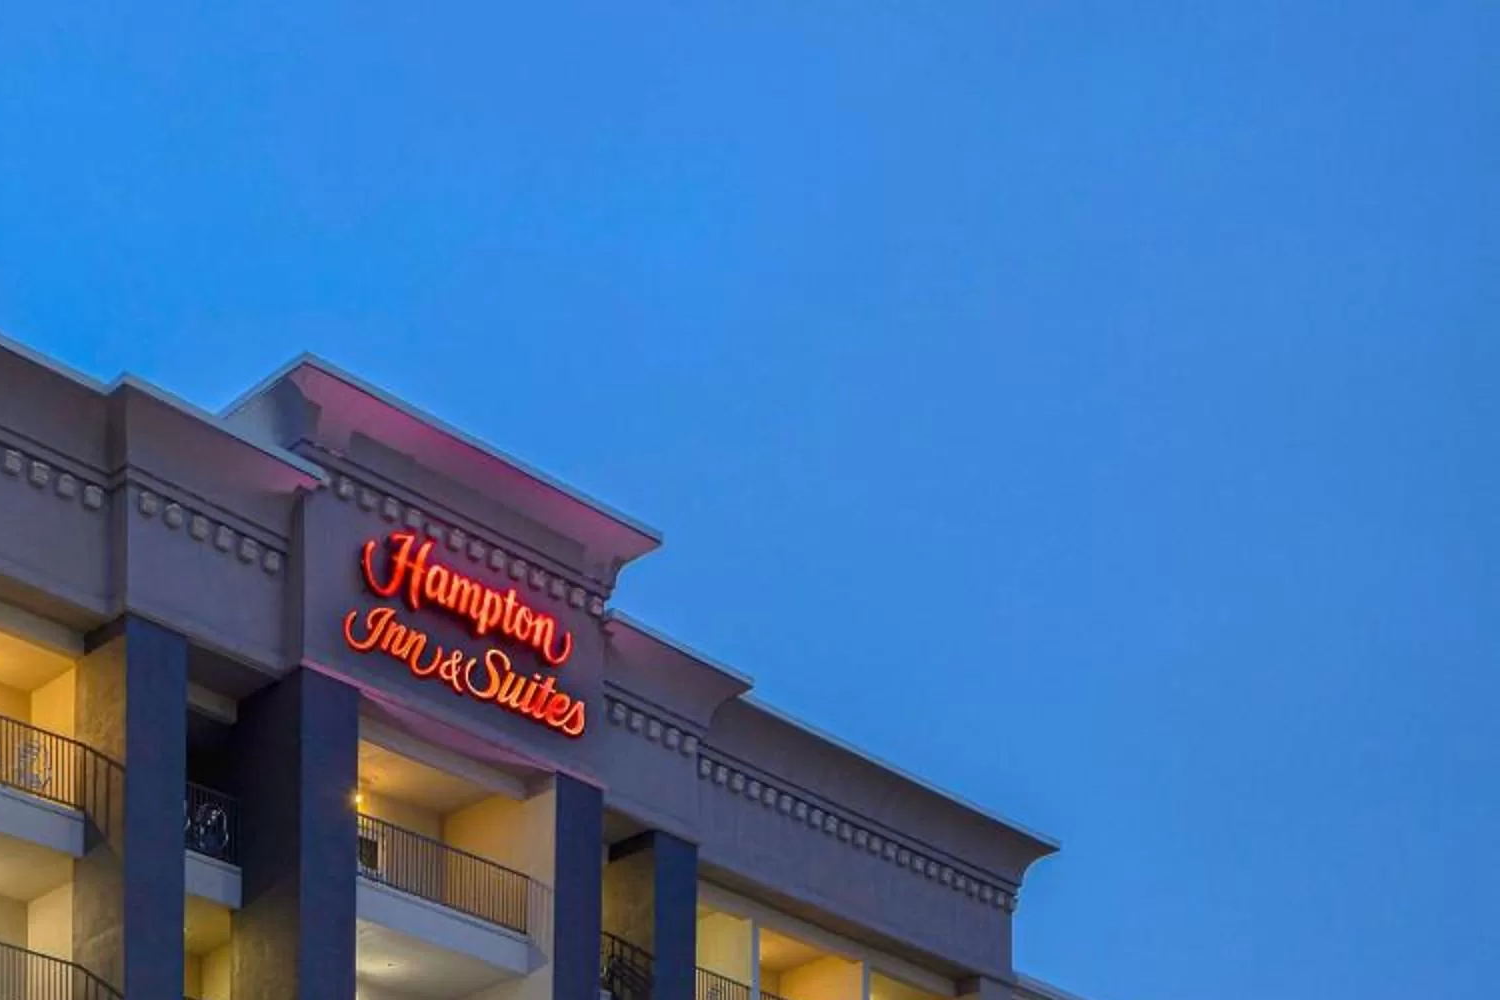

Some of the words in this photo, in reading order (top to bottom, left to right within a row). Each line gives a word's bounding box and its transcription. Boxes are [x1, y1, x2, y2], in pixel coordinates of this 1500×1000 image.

[362, 531, 573, 665] Hampton
[343, 606, 443, 676] Inn
[438, 650, 464, 693] &
[464, 648, 587, 736] Suites
